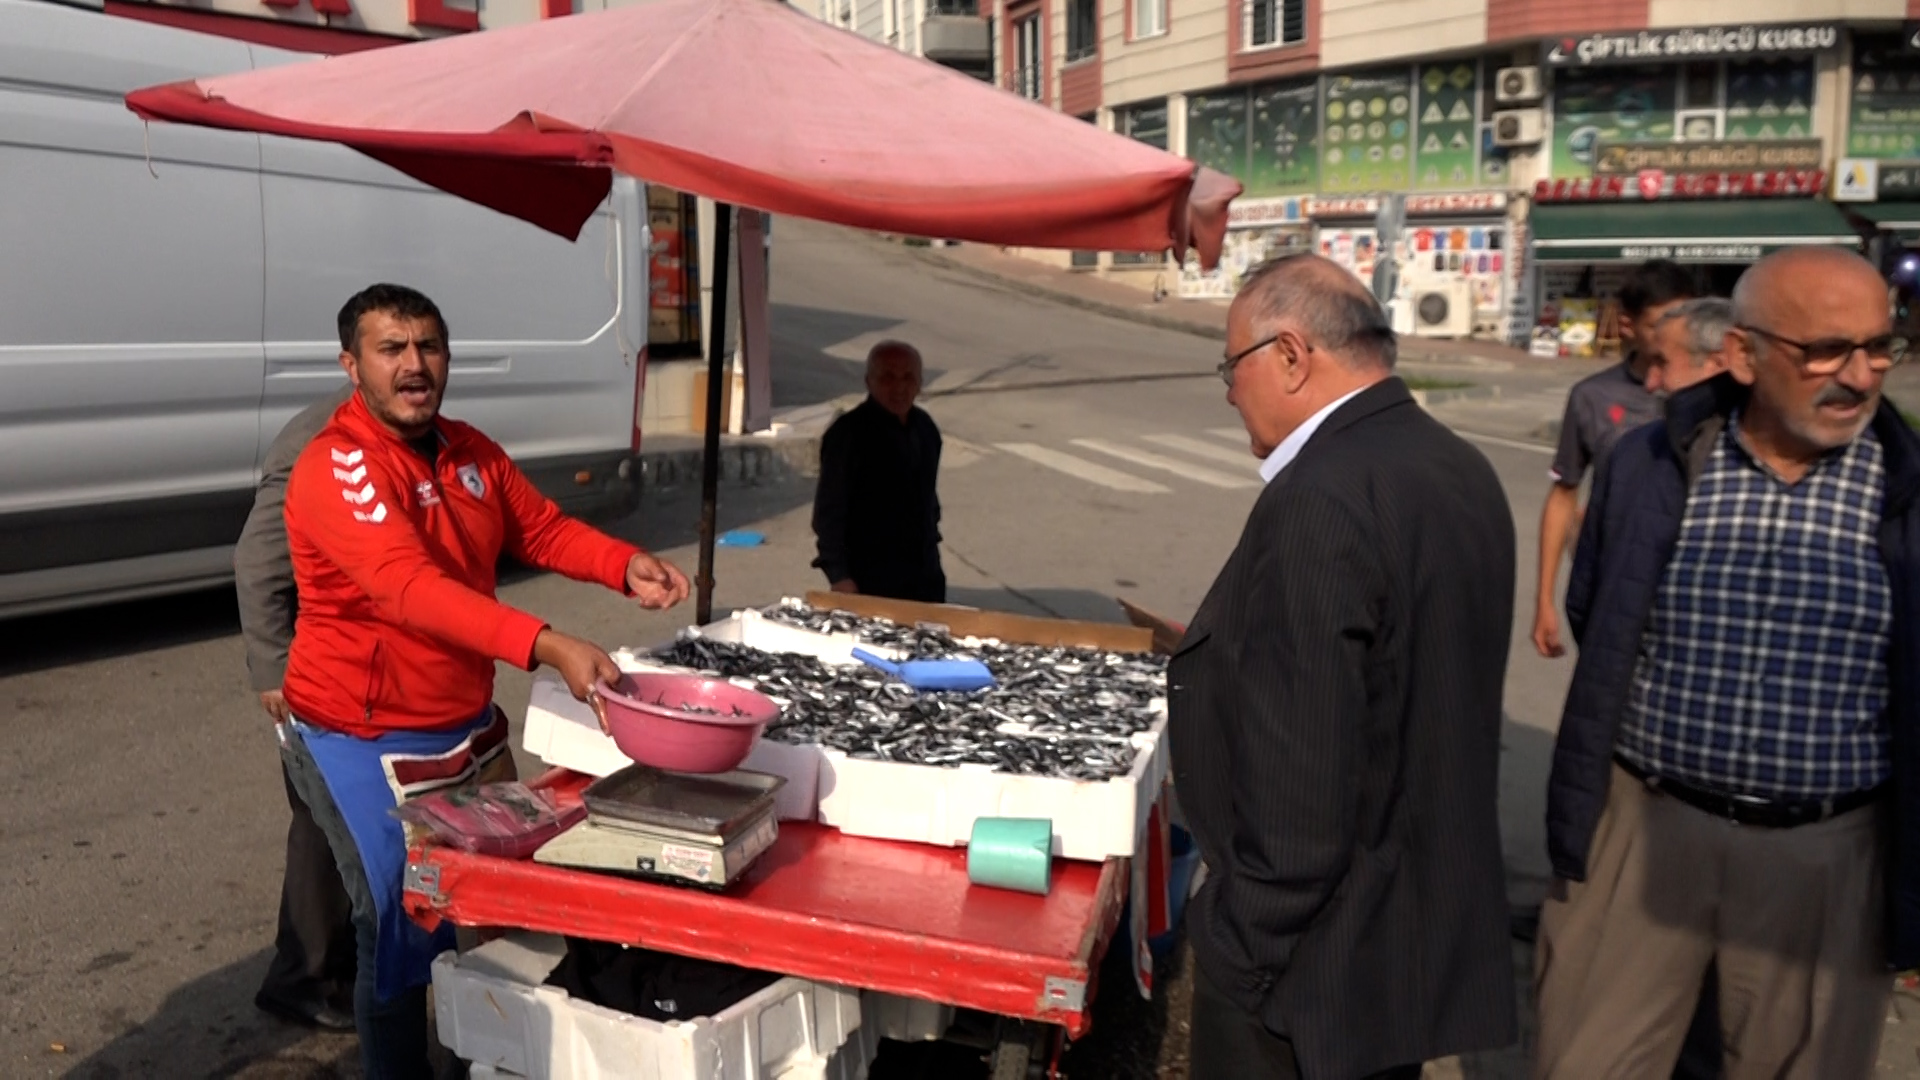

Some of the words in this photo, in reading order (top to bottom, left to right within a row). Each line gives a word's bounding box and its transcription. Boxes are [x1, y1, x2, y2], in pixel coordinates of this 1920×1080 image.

[1577, 33, 1662, 64] ÇİFTLİK
[1664, 27, 1755, 55] SÜRÜCÜ
[1757, 26, 1837, 51] KURSU
[1759, 146, 1819, 164] KURSU
